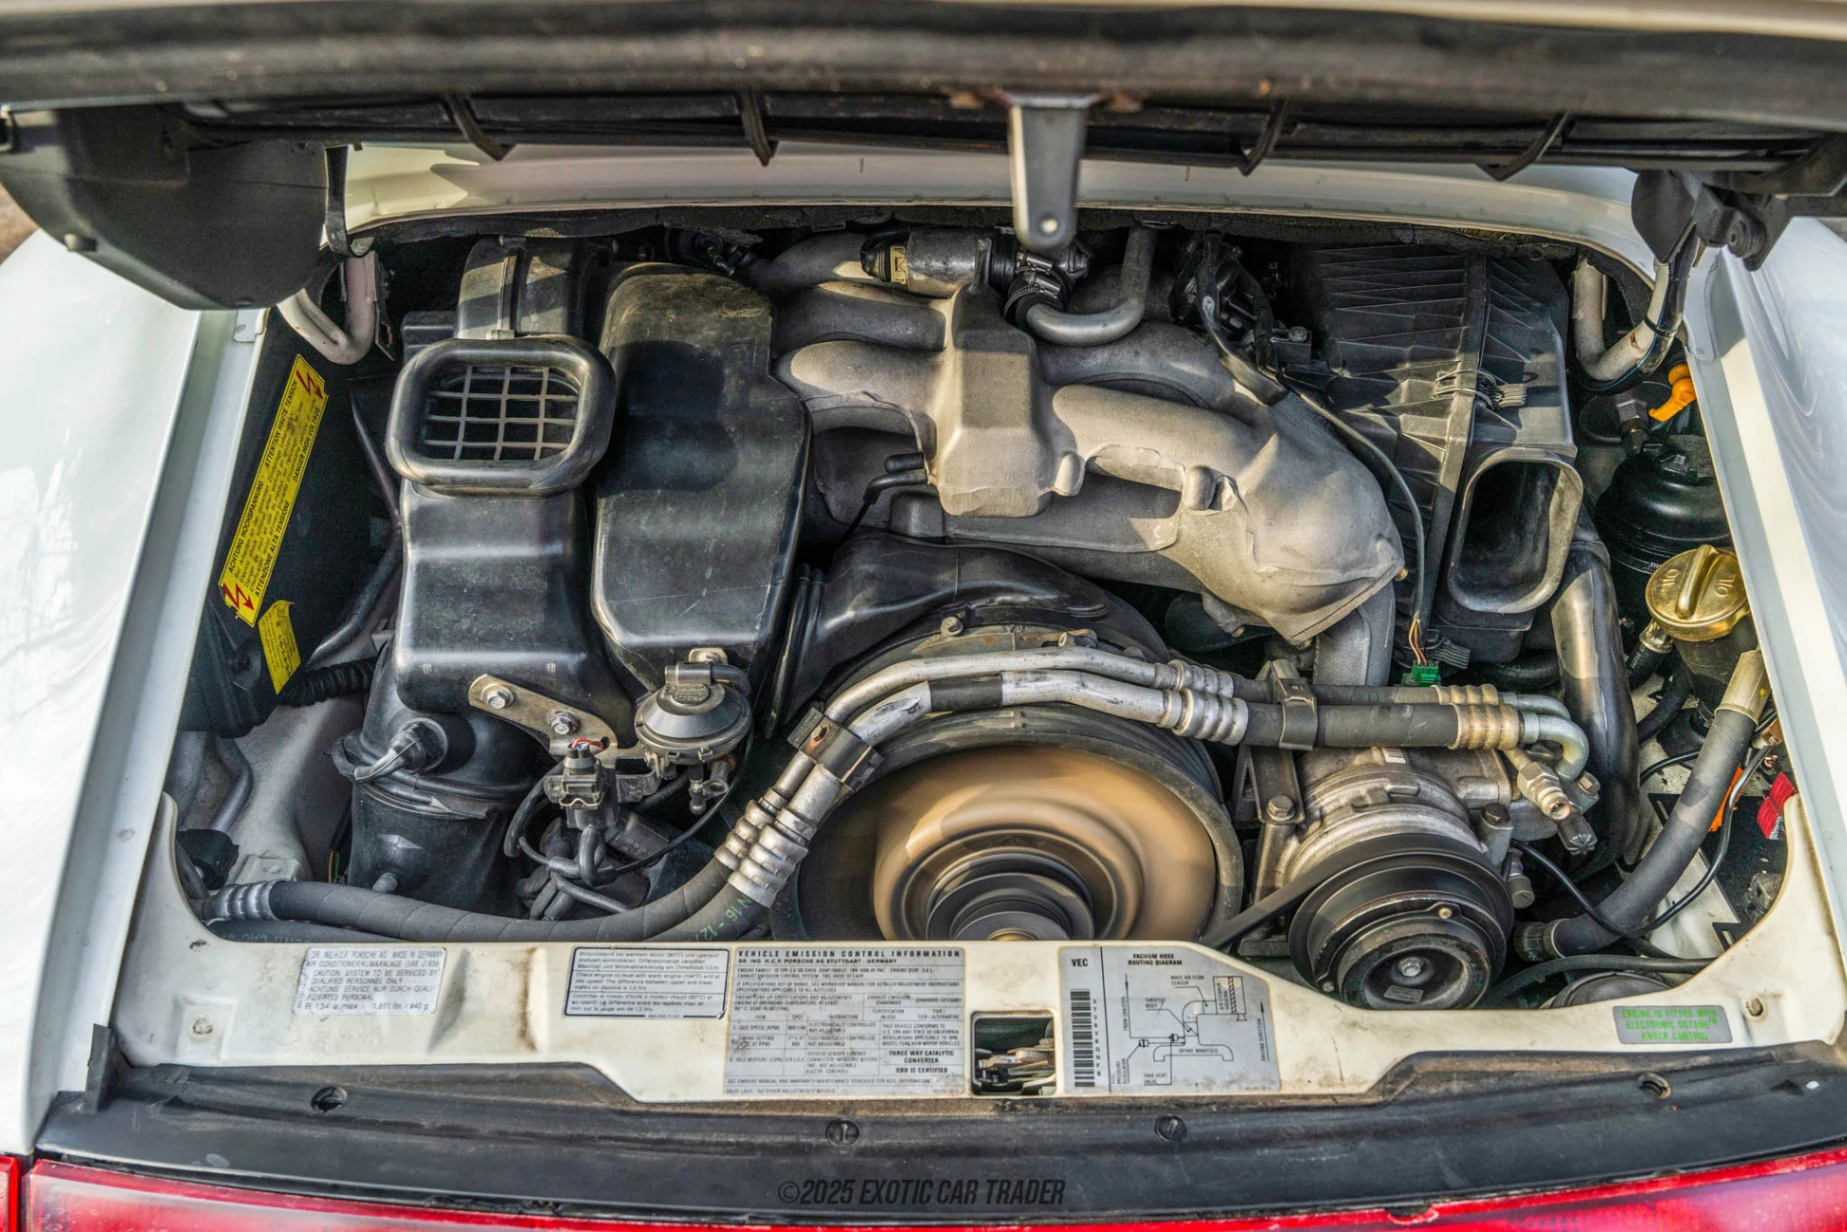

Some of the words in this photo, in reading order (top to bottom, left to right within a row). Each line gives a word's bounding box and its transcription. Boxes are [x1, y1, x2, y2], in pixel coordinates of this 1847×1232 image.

[265, 433, 281, 468] ATTENTION
[277, 408, 289, 433] HAUTE
[286, 380, 298, 408] TENSION
[294, 452, 307, 483] DANGER
[303, 437, 311, 455] HIGH
[228, 540, 244, 574] ACHTUNG
[240, 480, 264, 536] HOCHSPANNUNG
[255, 555, 272, 597] ATTENZIONE
[270, 534, 280, 554] ALTA
[276, 500, 290, 532] TENSIONE
[1071, 958, 1088, 968] VEC
